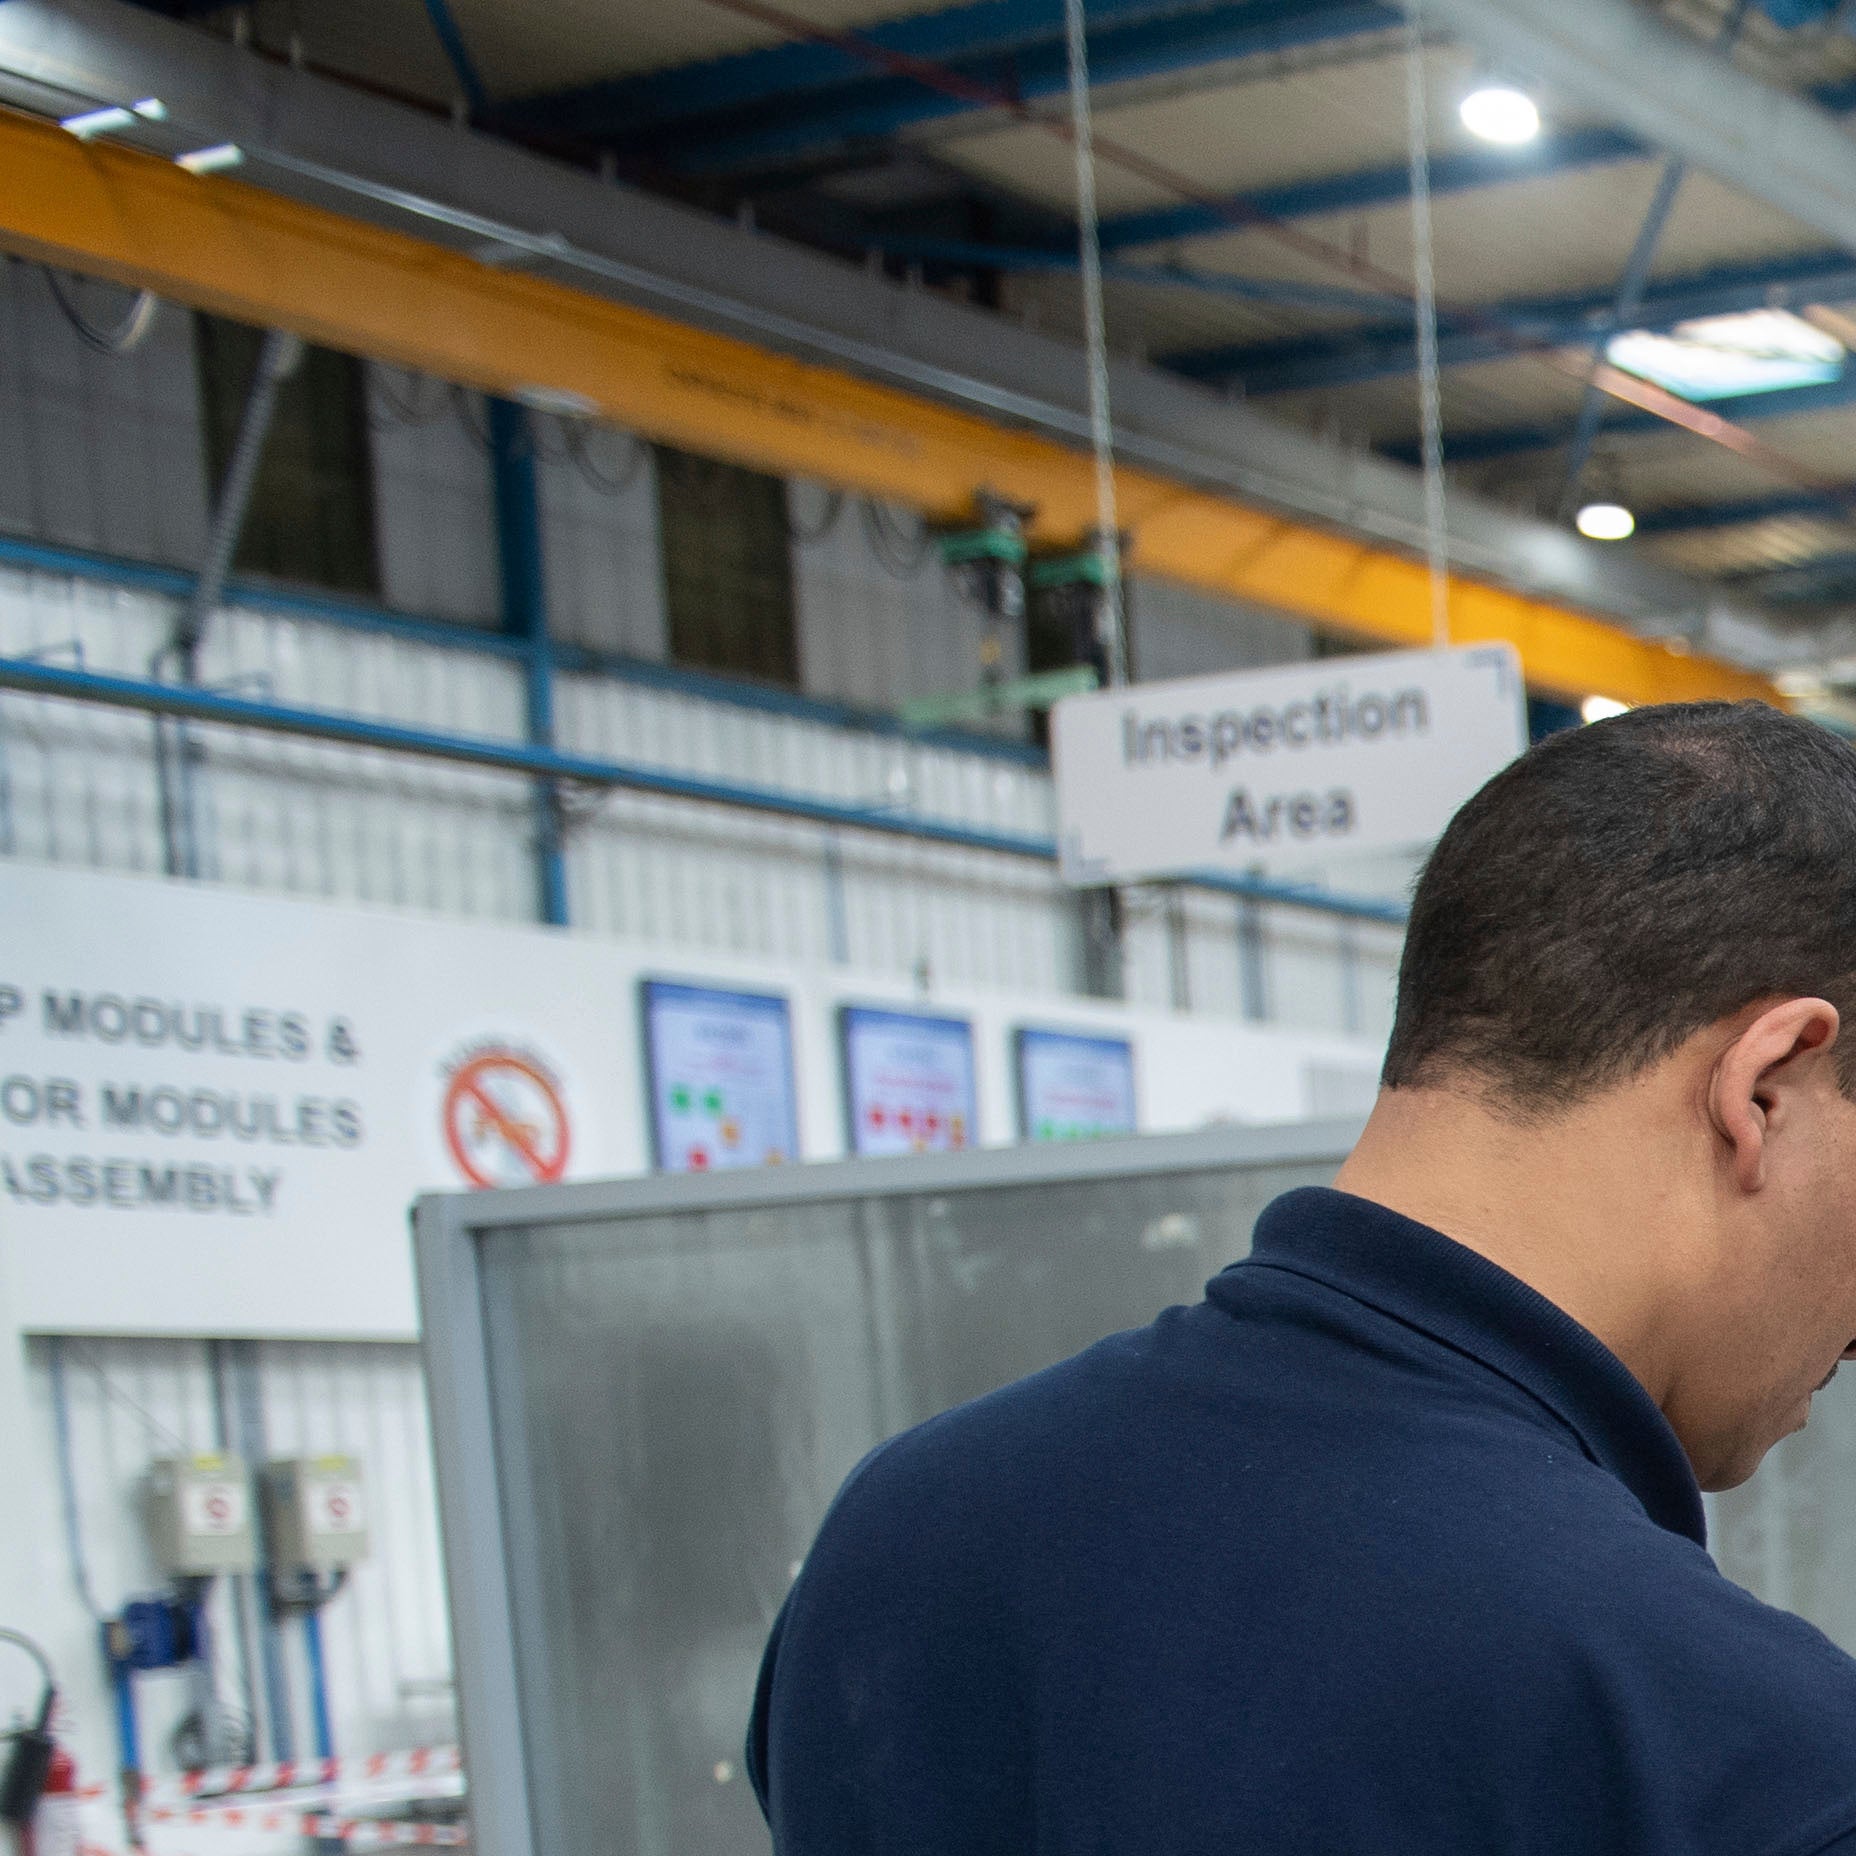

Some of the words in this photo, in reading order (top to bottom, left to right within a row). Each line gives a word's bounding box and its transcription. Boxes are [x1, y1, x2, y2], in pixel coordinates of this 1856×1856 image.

[1122, 683, 1431, 769] Inspection
[1219, 787, 1358, 850] Area
[41, 985, 313, 1061] MODULES
[325, 1014, 362, 1066] &
[99, 1080, 365, 1148] MODULES
